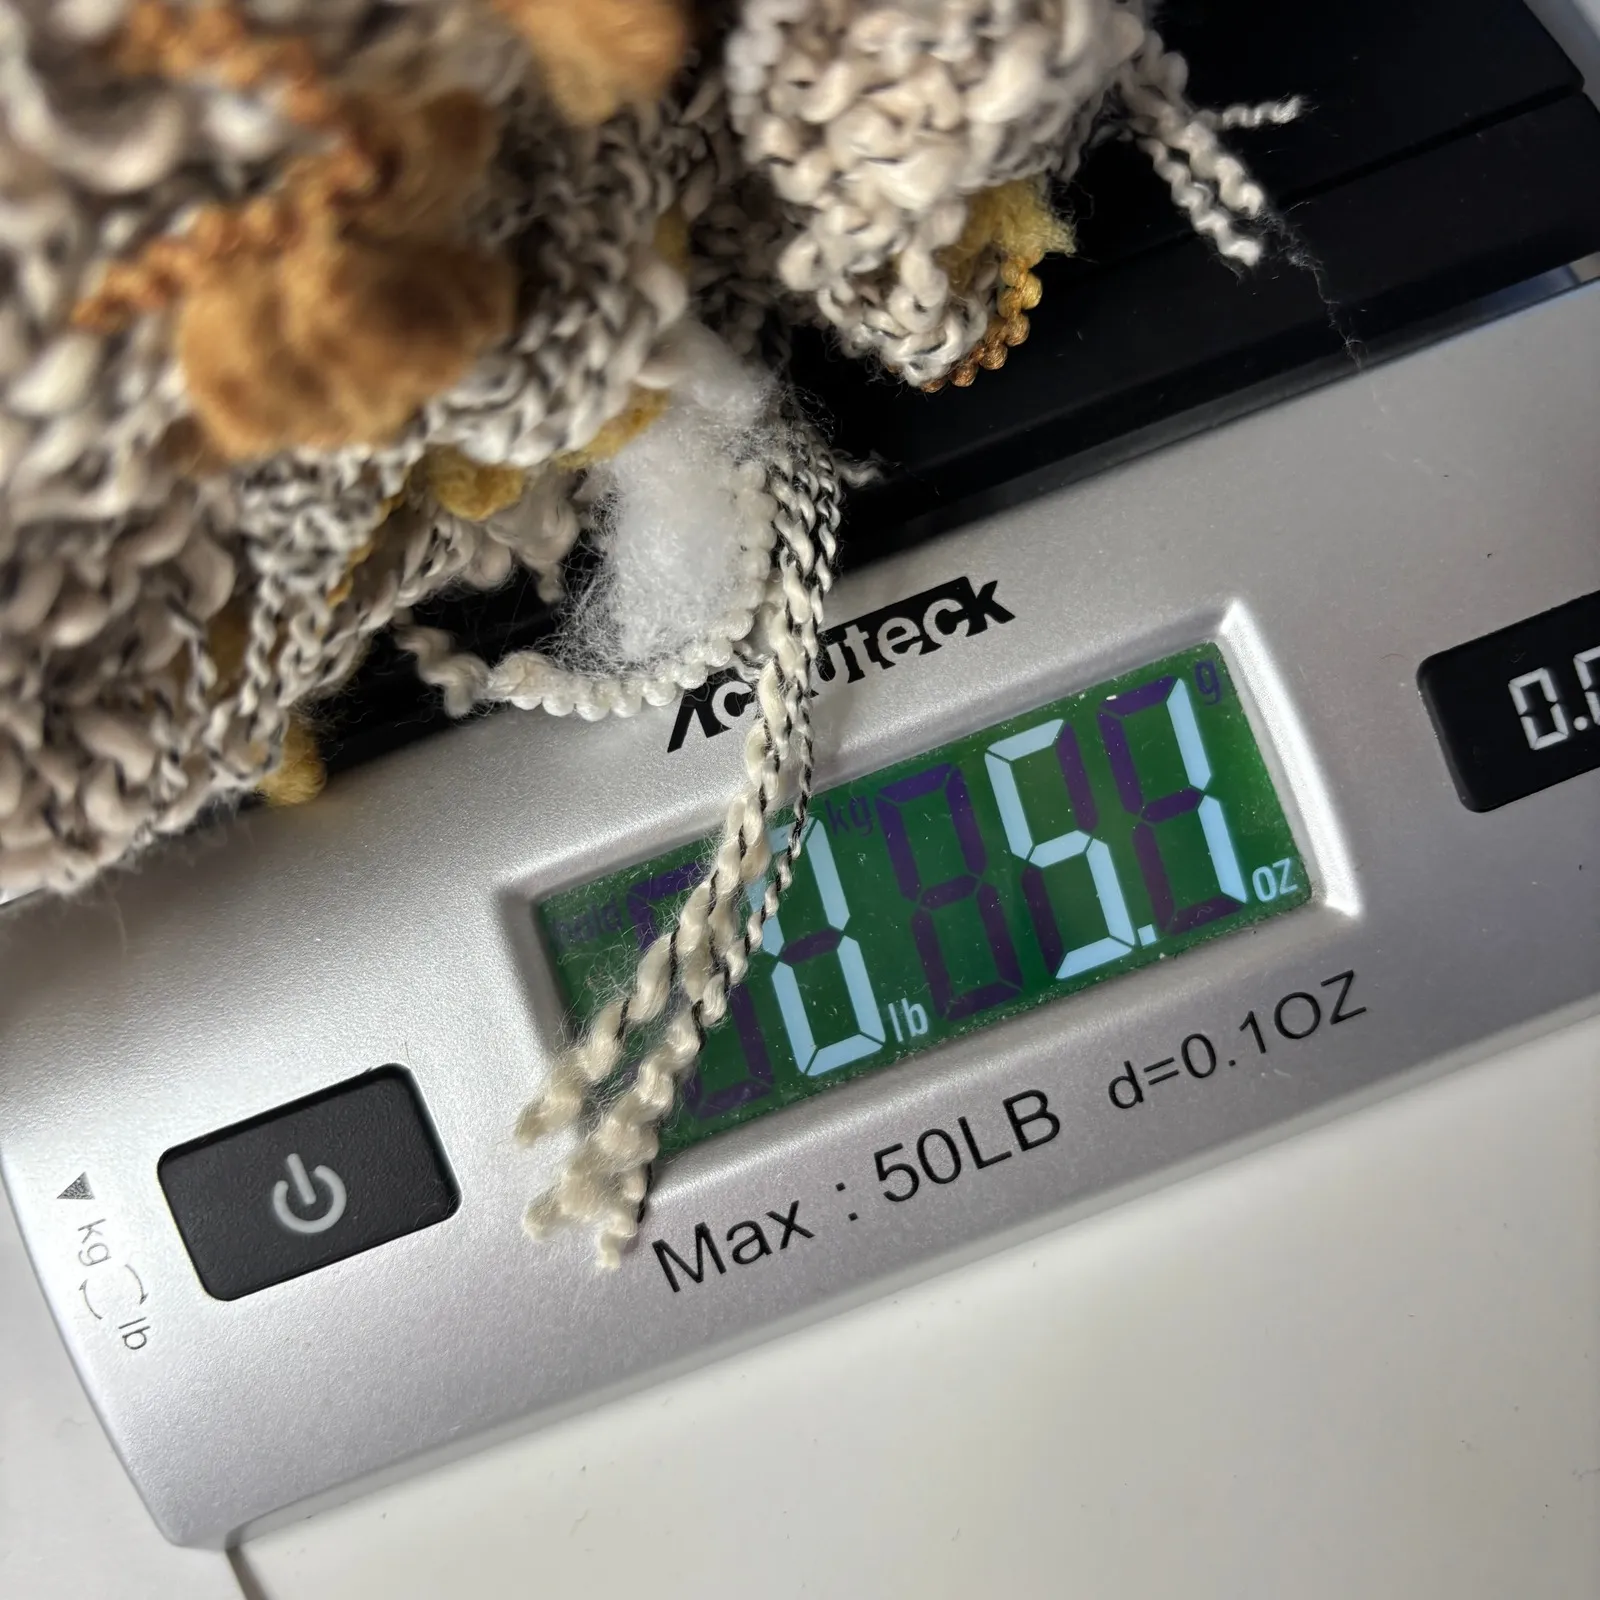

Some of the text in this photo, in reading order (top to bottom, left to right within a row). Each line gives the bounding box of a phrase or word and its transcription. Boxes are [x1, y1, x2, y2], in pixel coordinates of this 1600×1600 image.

[666, 575, 1016, 753] Acuteck
[740, 816, 886, 1077] 0
[887, 997, 930, 1043] lb
[984, 677, 1248, 981] 5.1
[650, 1200, 816, 1293] Max
[873, 1088, 1062, 1202] 50LB
[1107, 970, 1368, 1109] d=0.1OZ
[77, 1218, 112, 1267] kg
[117, 1316, 151, 1351] lb
